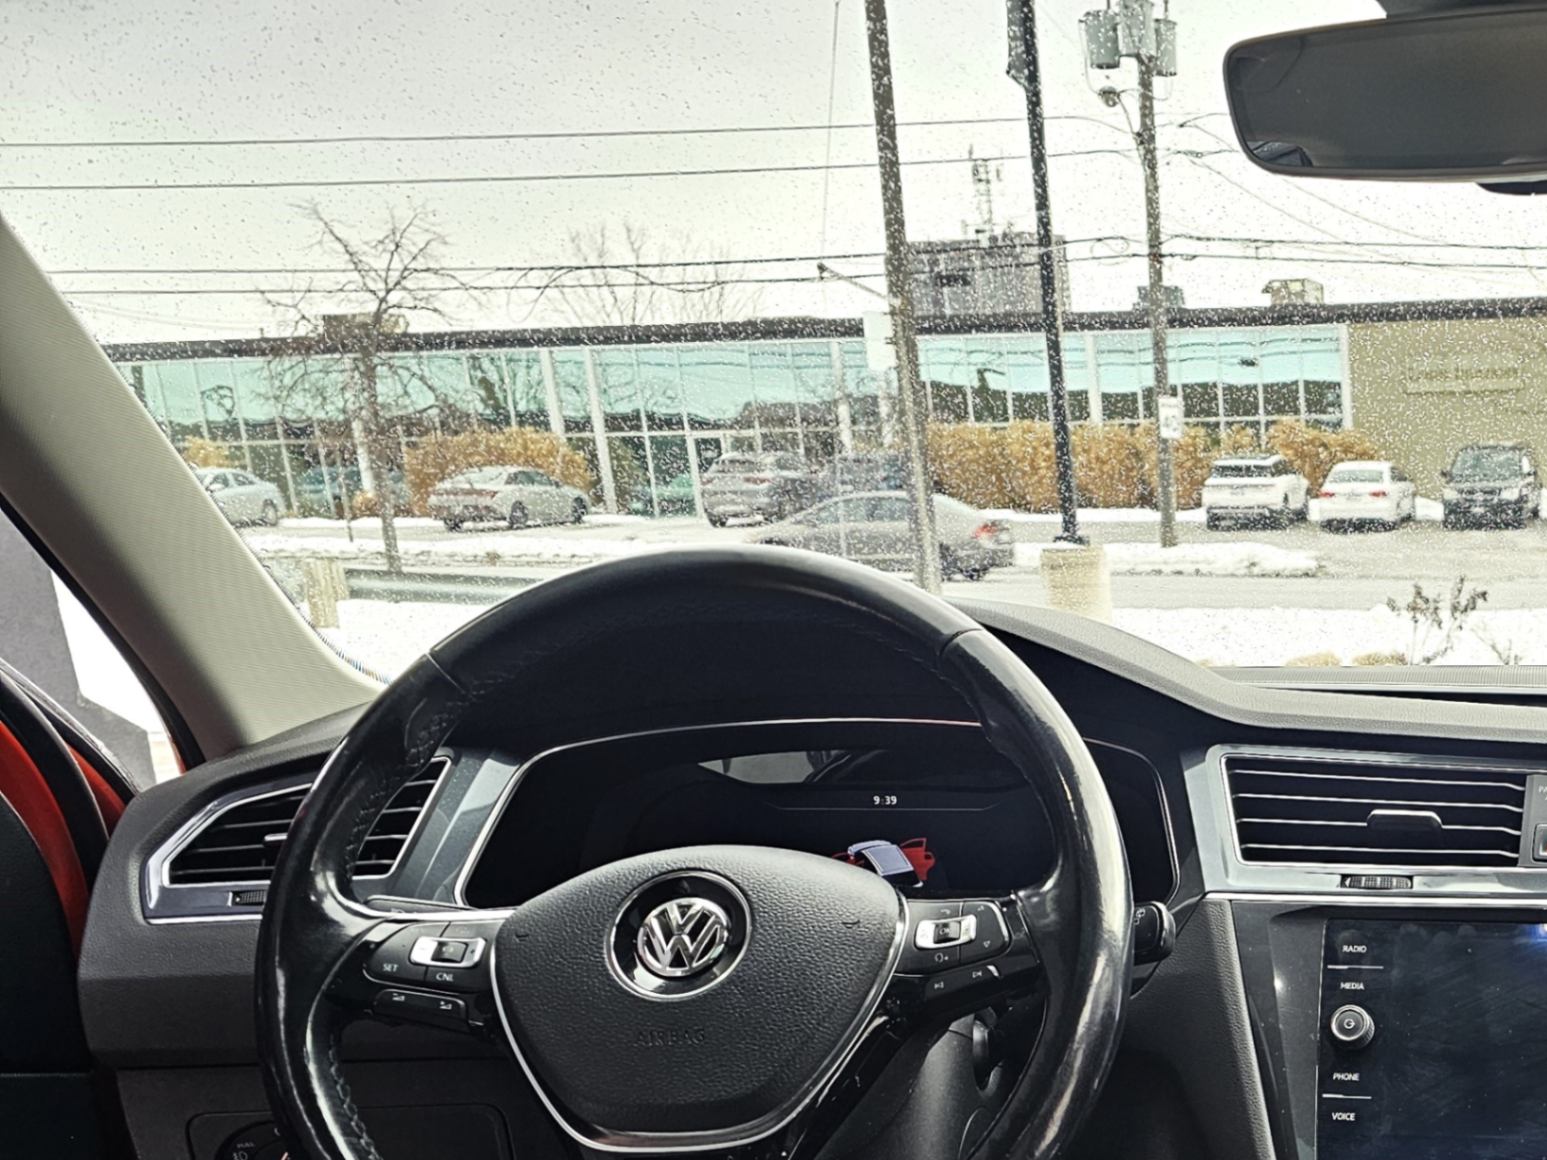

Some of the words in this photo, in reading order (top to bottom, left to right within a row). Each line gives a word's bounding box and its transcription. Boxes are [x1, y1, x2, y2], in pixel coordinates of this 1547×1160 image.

[1342, 944, 1367, 953] RADIO
[383, 963, 398, 972] SET
[436, 972, 454, 982] CNL
[1340, 981, 1365, 990] MEDIA
[1332, 1072, 1360, 1081] PHONE
[1331, 1112, 1356, 1121] VOICE
